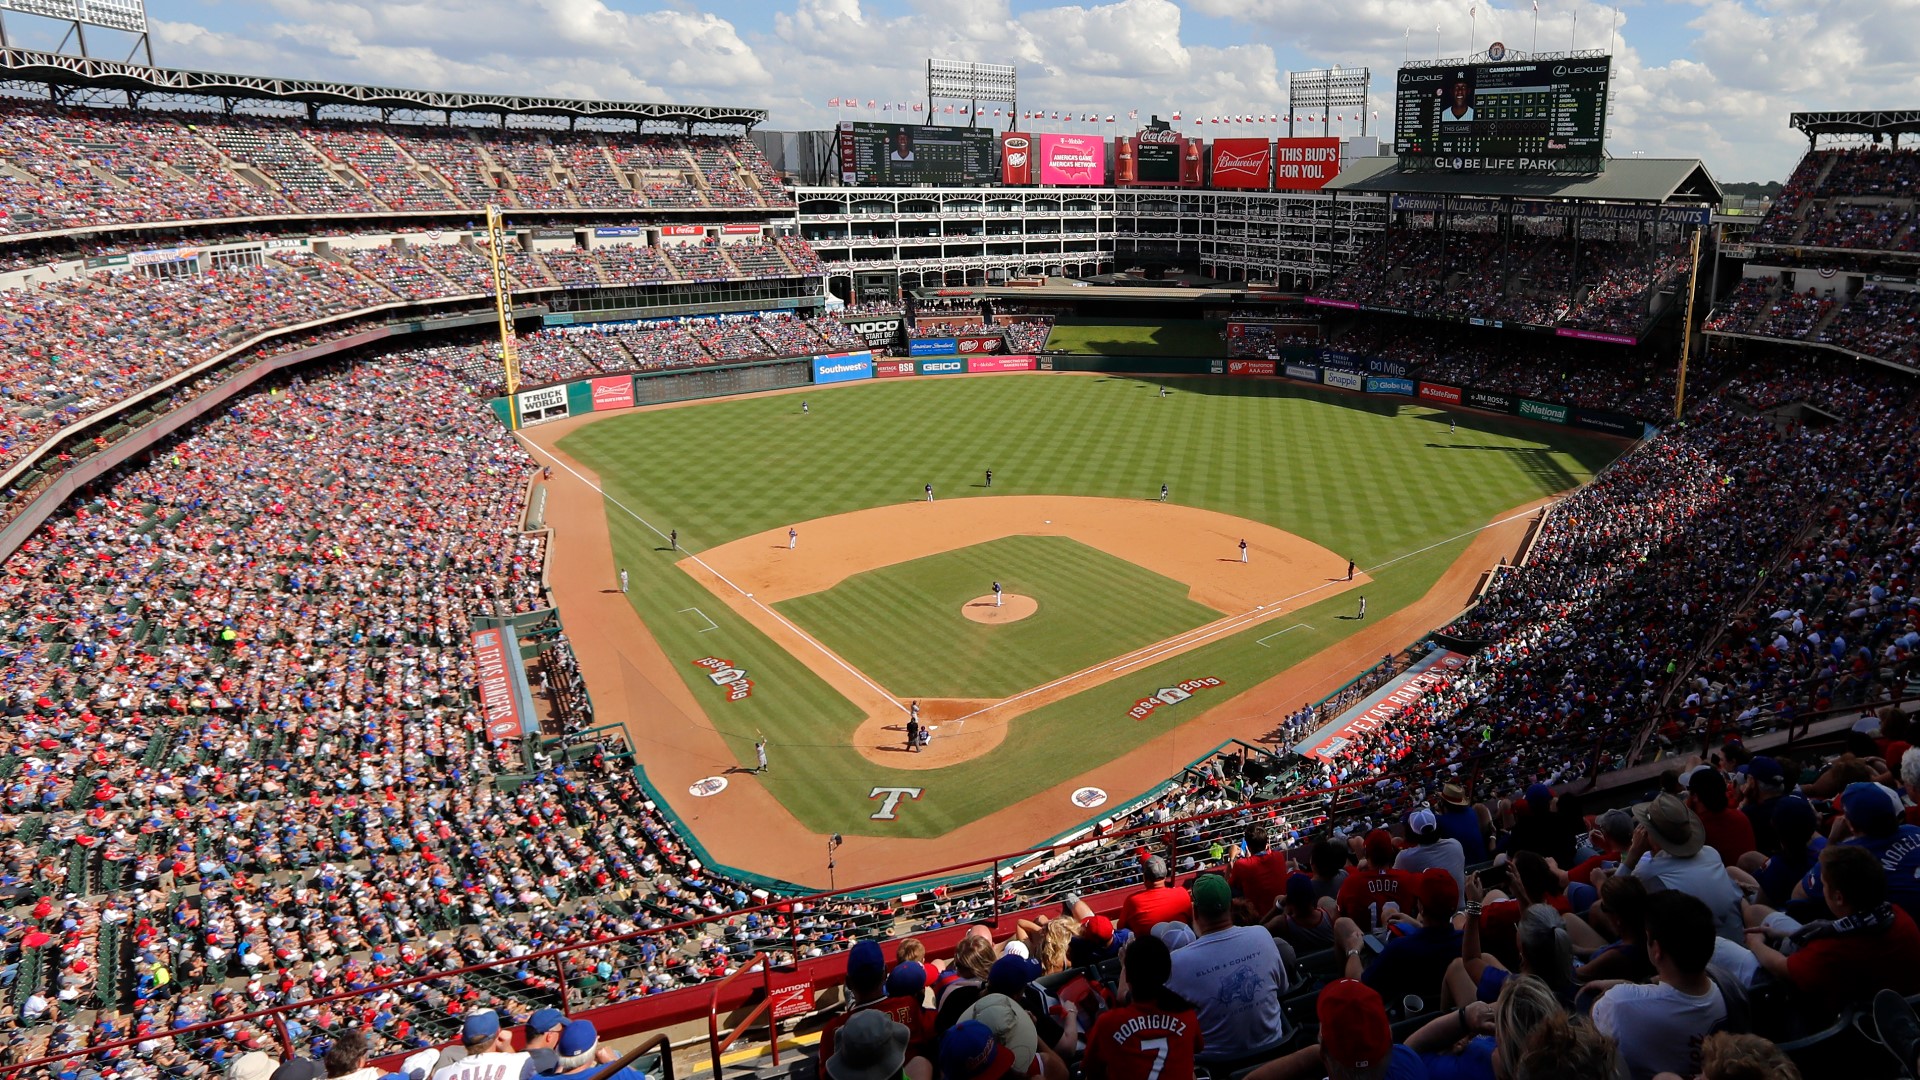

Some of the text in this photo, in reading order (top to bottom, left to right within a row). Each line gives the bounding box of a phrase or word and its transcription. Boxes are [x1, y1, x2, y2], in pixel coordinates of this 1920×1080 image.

[1280, 148, 1336, 162] THIS BUD'S
[1218, 156, 1262, 168] Budweiser
[1434, 157, 1557, 169] GLOBE LIFE PARK
[1280, 165, 1324, 178] FOR YOU.
[1658, 208, 1702, 222] PAINTS
[134, 254, 160, 265] SHOCK
[494, 228, 513, 330] EAT MOR FOWL
[742, 281, 759, 289] JACK
[593, 288, 613, 298] JACK
[671, 284, 689, 294] JACK
[851, 320, 899, 334] NOCO
[866, 331, 883, 340] START
[820, 362, 861, 374] Southwest
[899, 363, 914, 372] BSB
[923, 362, 960, 371] GEICO
[1328, 373, 1357, 387] Snapple
[524, 390, 562, 403] TRUCK
[1488, 395, 1504, 404] ROSS
[524, 397, 562, 410] WORLD
[1530, 405, 1565, 418] National
[697, 657, 731, 671] 1994
[480, 648, 512, 720] TEXAS RANGERS
[730, 679, 749, 700] 2019
[1129, 697, 1161, 719] 1994
[1180, 677, 1220, 692] 2019
[1344, 666, 1443, 734] TEXAS RANGERS
[868, 786, 926, 822] T
[1881, 834, 1920, 871] MOREL
[1368, 880, 1398, 892] ODOR
[1196, 951, 1262, 978] ELLIS COUNTY
[1113, 1014, 1186, 1045] RODRIGUEZ
[1141, 1038, 1168, 1080] 7
